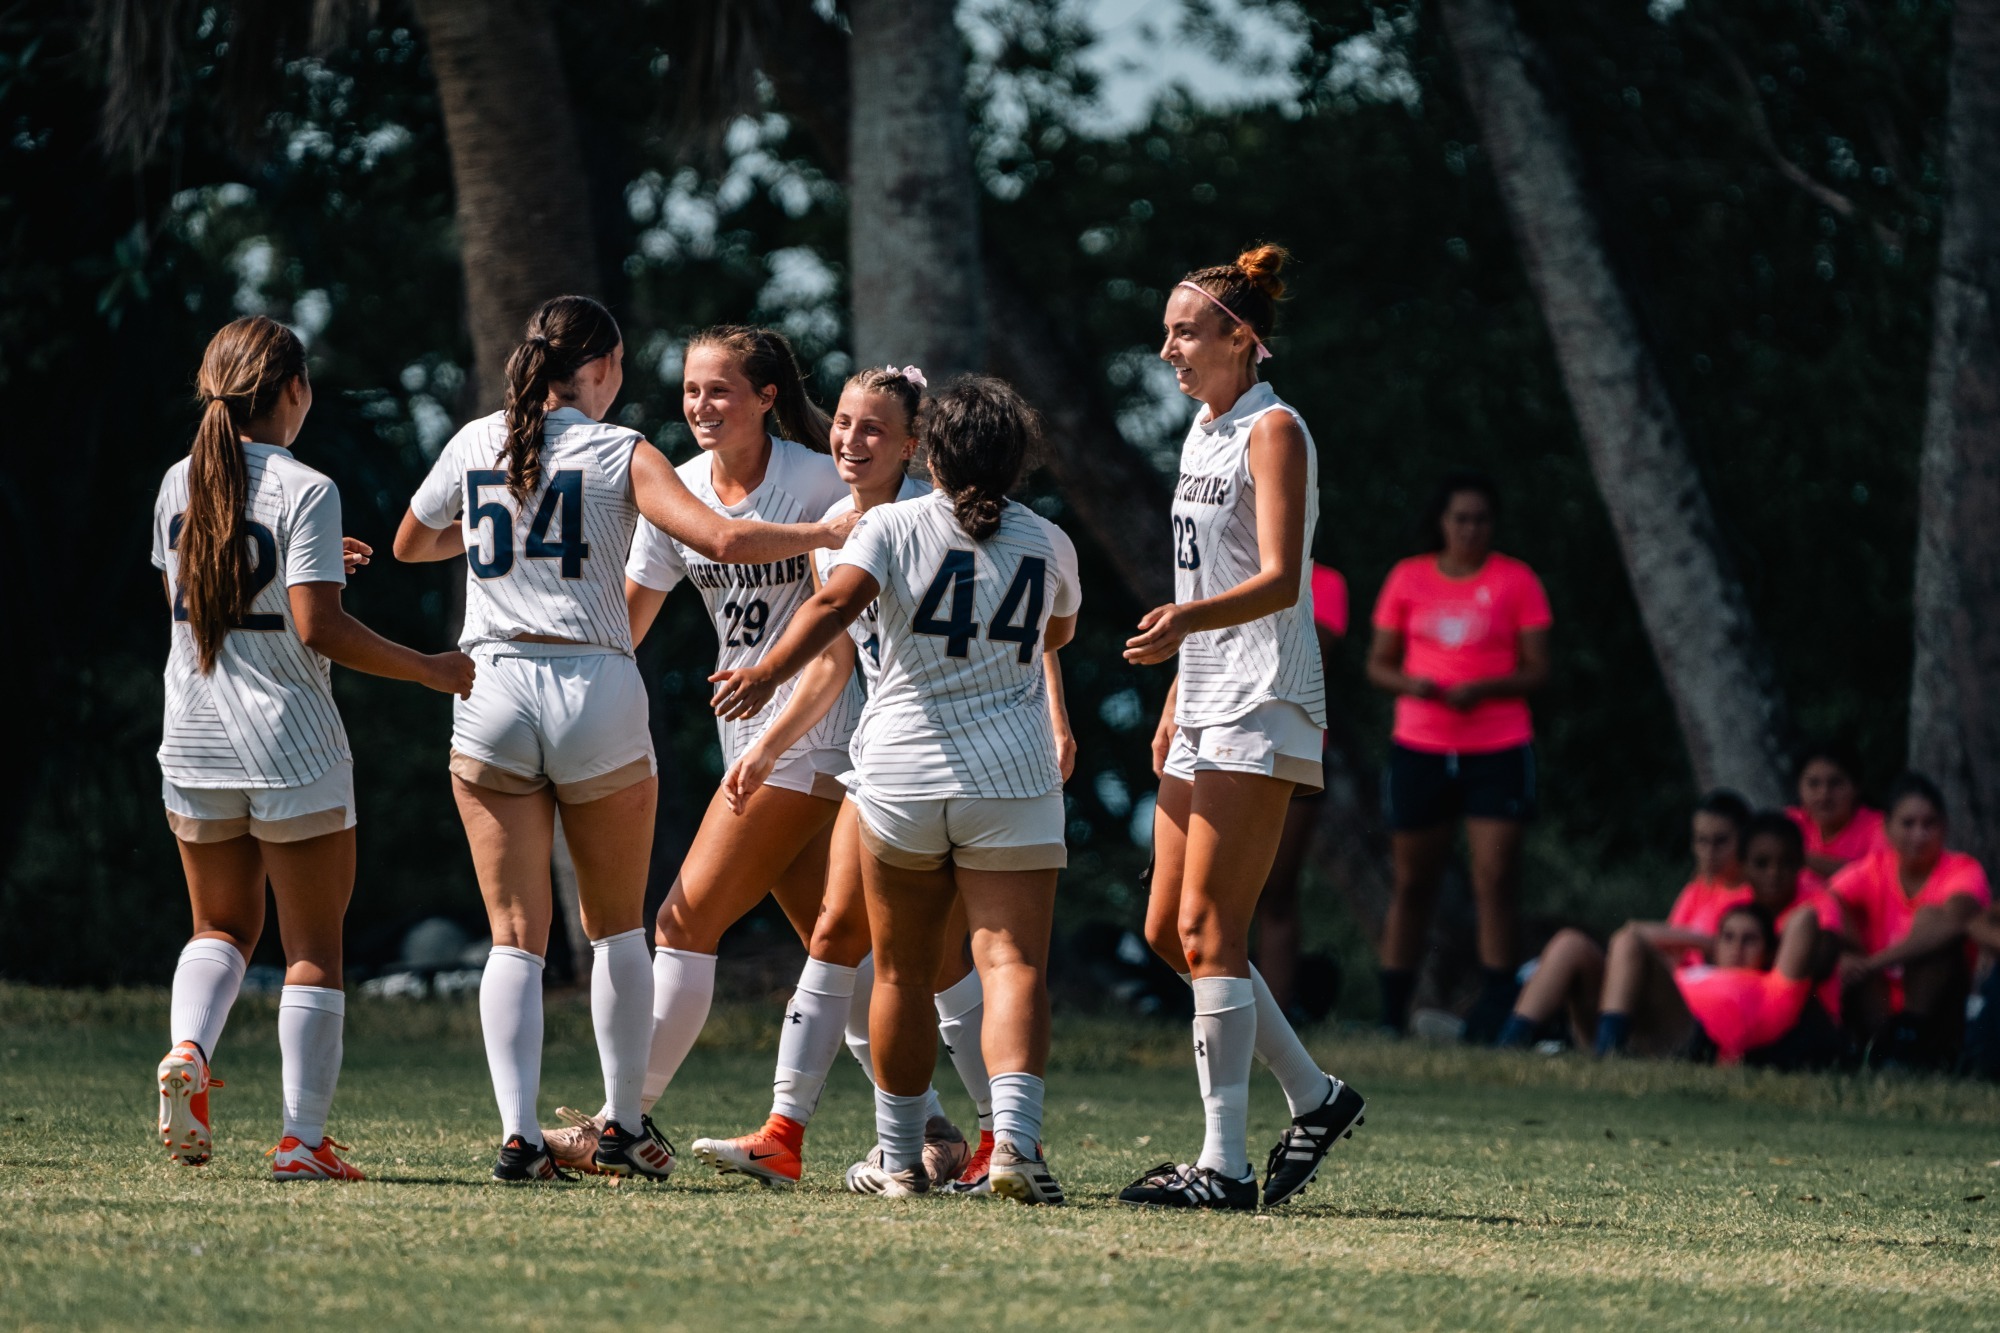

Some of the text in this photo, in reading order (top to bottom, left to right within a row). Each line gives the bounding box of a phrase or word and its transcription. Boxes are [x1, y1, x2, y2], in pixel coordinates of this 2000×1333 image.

[466, 468, 591, 580] 54
[1173, 514, 1200, 571] 23
[734, 554, 806, 589] BANYANS
[724, 598, 769, 648] 29
[911, 547, 1049, 665] 44
